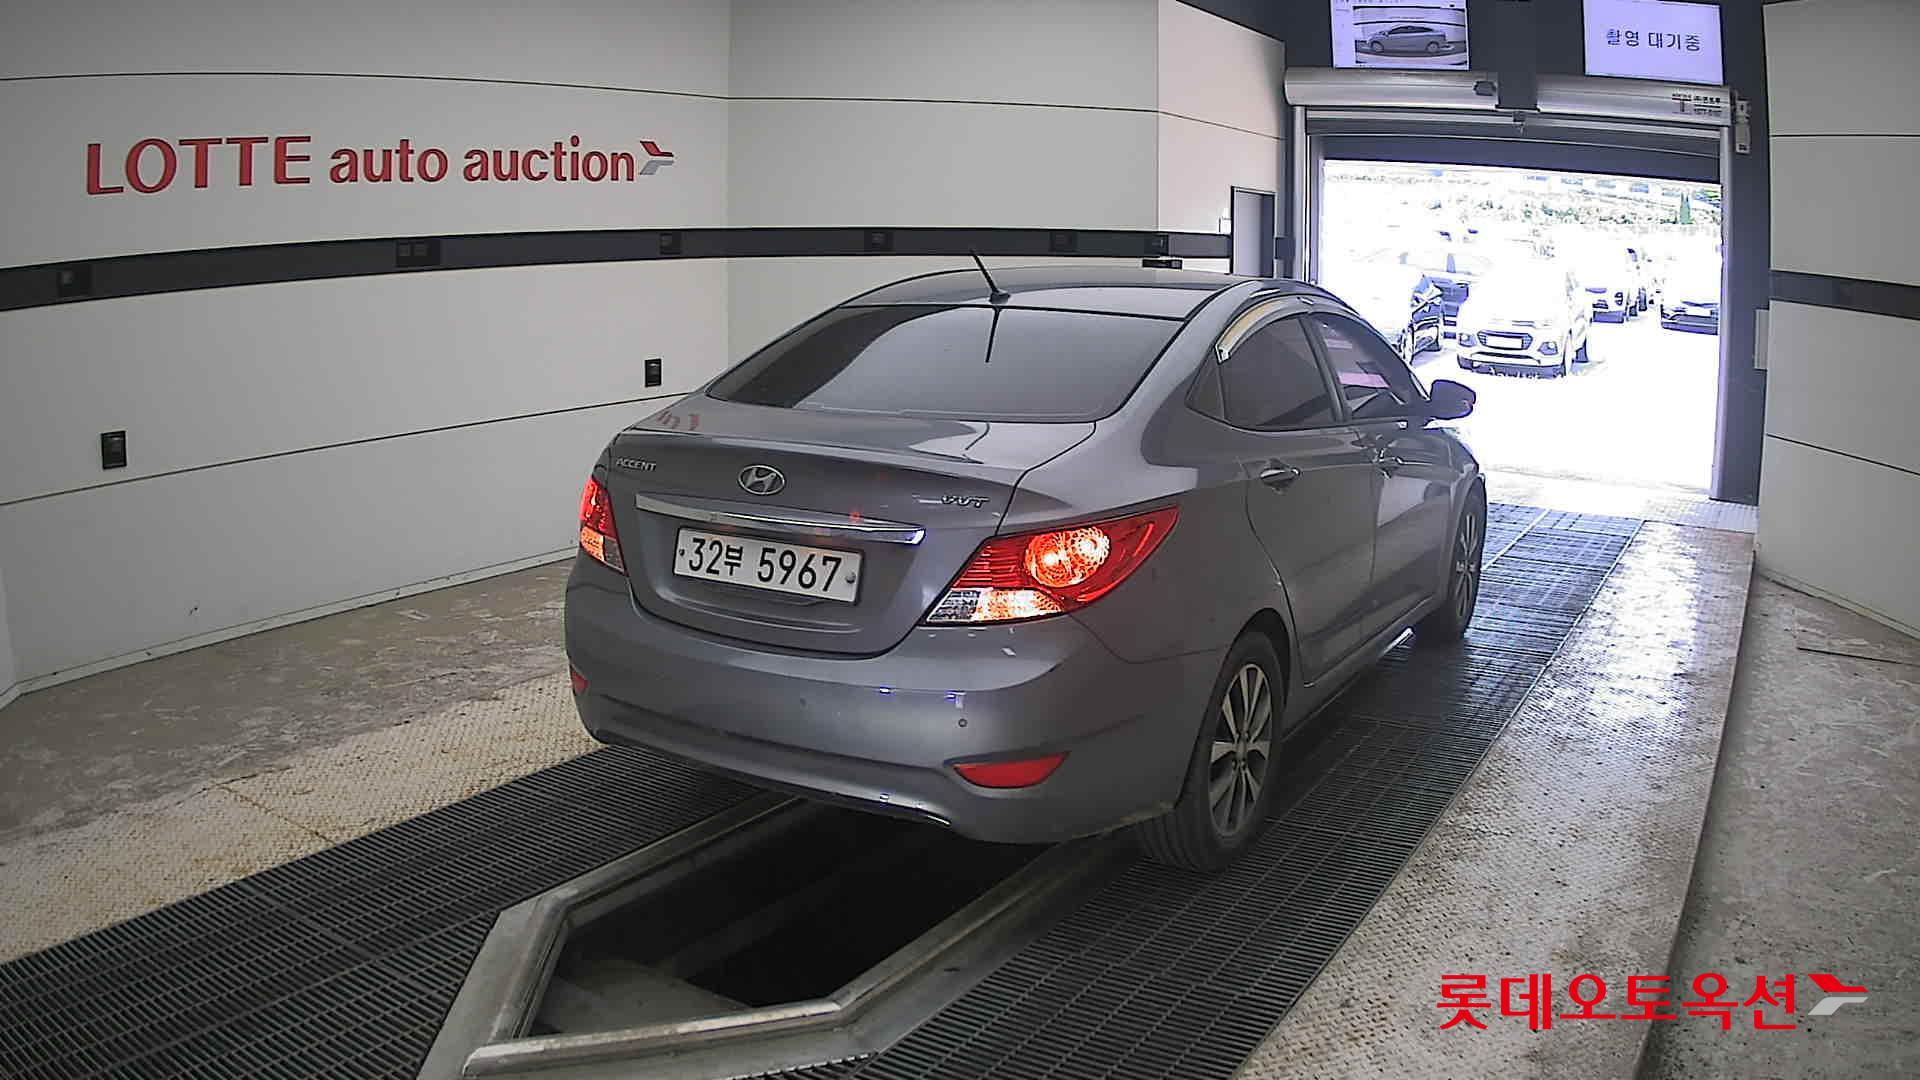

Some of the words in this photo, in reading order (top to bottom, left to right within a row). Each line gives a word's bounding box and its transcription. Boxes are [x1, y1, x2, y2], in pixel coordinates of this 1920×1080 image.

[1648, 31, 1701, 52] 대기중
[86, 135, 312, 196] LOTTE
[329, 138, 449, 184] auto
[462, 134, 637, 183] auction
[616, 457, 656, 472] ACCENT
[688, 537, 744, 577] 32부
[757, 547, 843, 593] 5967
